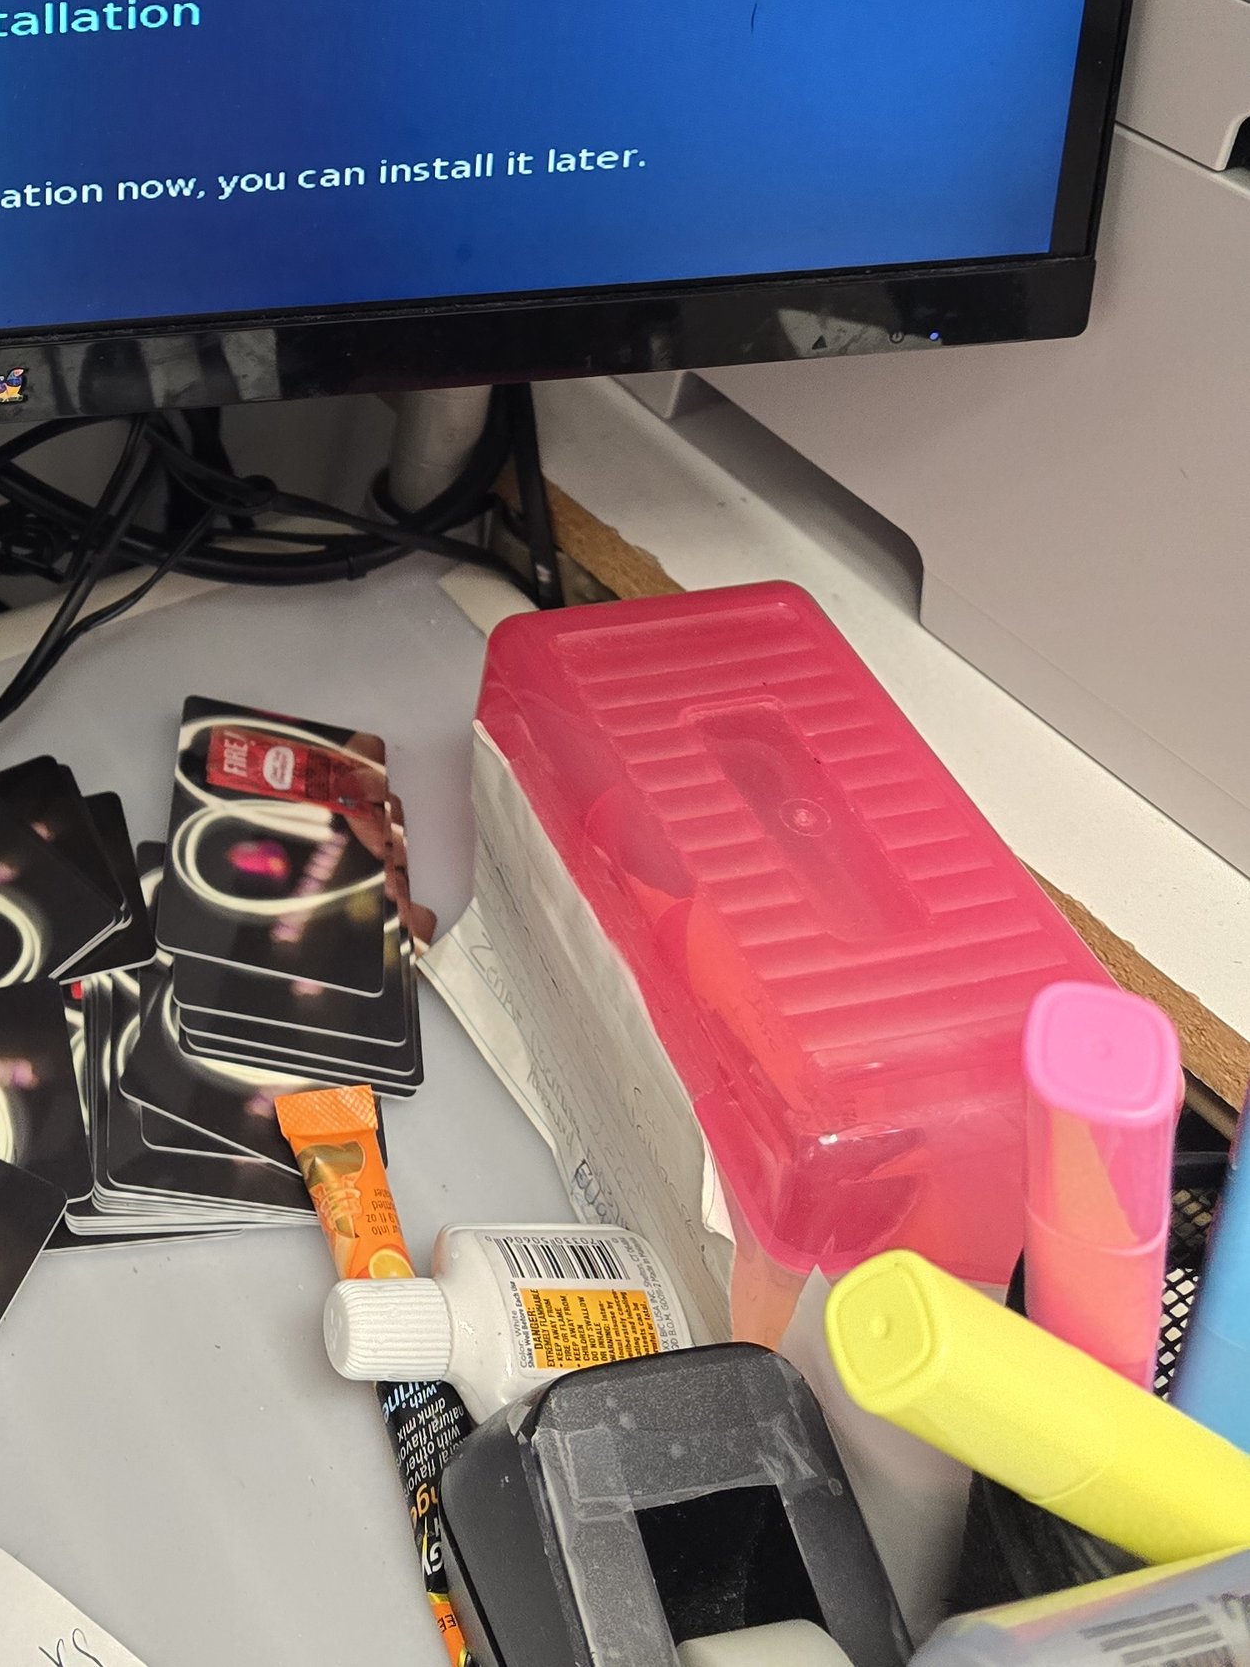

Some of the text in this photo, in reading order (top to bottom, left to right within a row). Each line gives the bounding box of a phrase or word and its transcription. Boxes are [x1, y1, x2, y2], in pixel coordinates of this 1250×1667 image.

[117, 177, 206, 201] now,
[217, 171, 286, 201] you
[297, 166, 366, 189] can
[379, 152, 494, 184] install
[507, 150, 534, 176] it
[547, 148, 646, 174] later.
[512, 1311, 521, 1336] White
[527, 1307, 544, 1350] DANGER:
[543, 1299, 563, 1361] KEEP AWAY FROM
[567, 1318, 578, 1339] AWAY
[577, 1296, 599, 1361] DO NOT SWALLOW
[653, 1306, 663, 1321] USA
[657, 1324, 667, 1337] BIC
[541, 1329, 555, 1367] EXTREMELY
[555, 1307, 572, 1361] FIRE OR FLAME
[572, 1341, 581, 1361] KEEP
[577, 1324, 590, 1361] CHILDREN
[594, 1322, 608, 1361] OR INHALE
[620, 1317, 633, 1357] eliberately
[410, 1384, 437, 1408] with
[417, 1397, 446, 1426] drink
[397, 1417, 417, 1443] mix
[428, 1405, 464, 1439] natural
[436, 1425, 460, 1450] with
[405, 1442, 435, 1476] other
